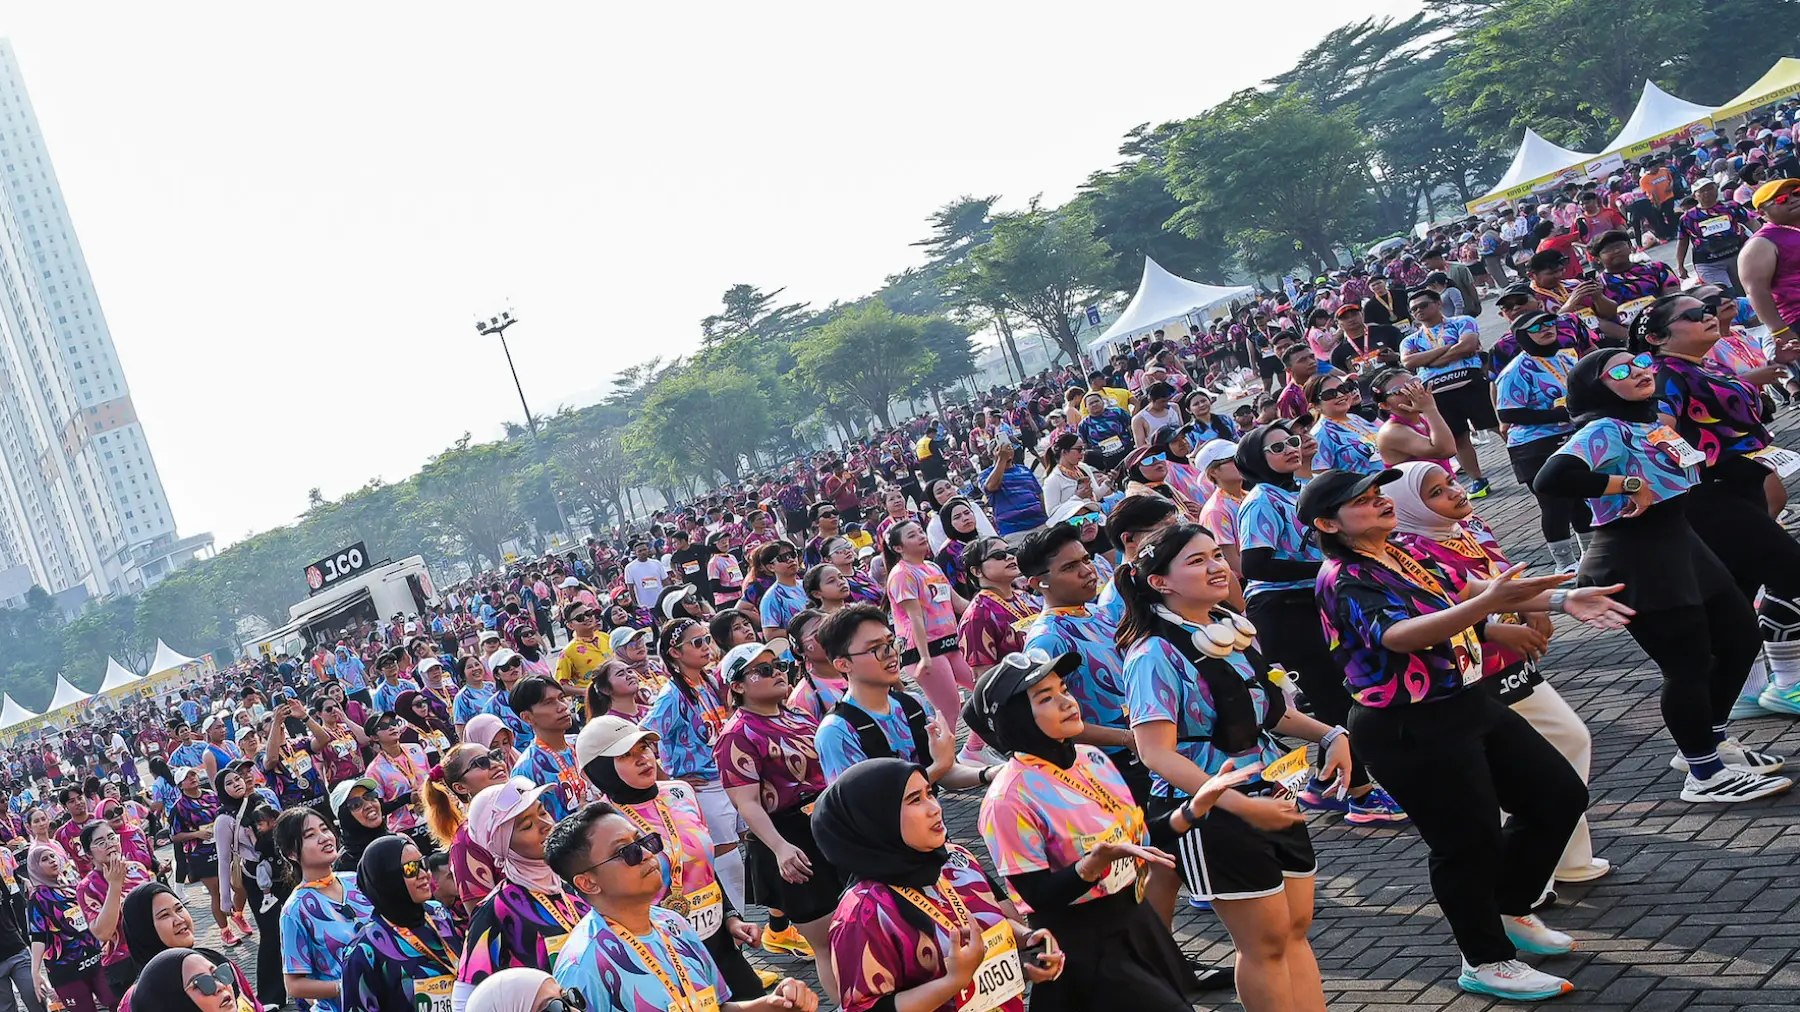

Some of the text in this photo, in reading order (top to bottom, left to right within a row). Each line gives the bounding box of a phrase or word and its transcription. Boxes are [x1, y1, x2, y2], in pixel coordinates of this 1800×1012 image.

[901, 886, 940, 918] NISHER
[689, 909, 713, 932] 712
[620, 931, 661, 976] FINISHER
[987, 934, 1004, 950] RUN
[666, 943, 689, 986] JCORUN
[978, 959, 1014, 997] 4050
